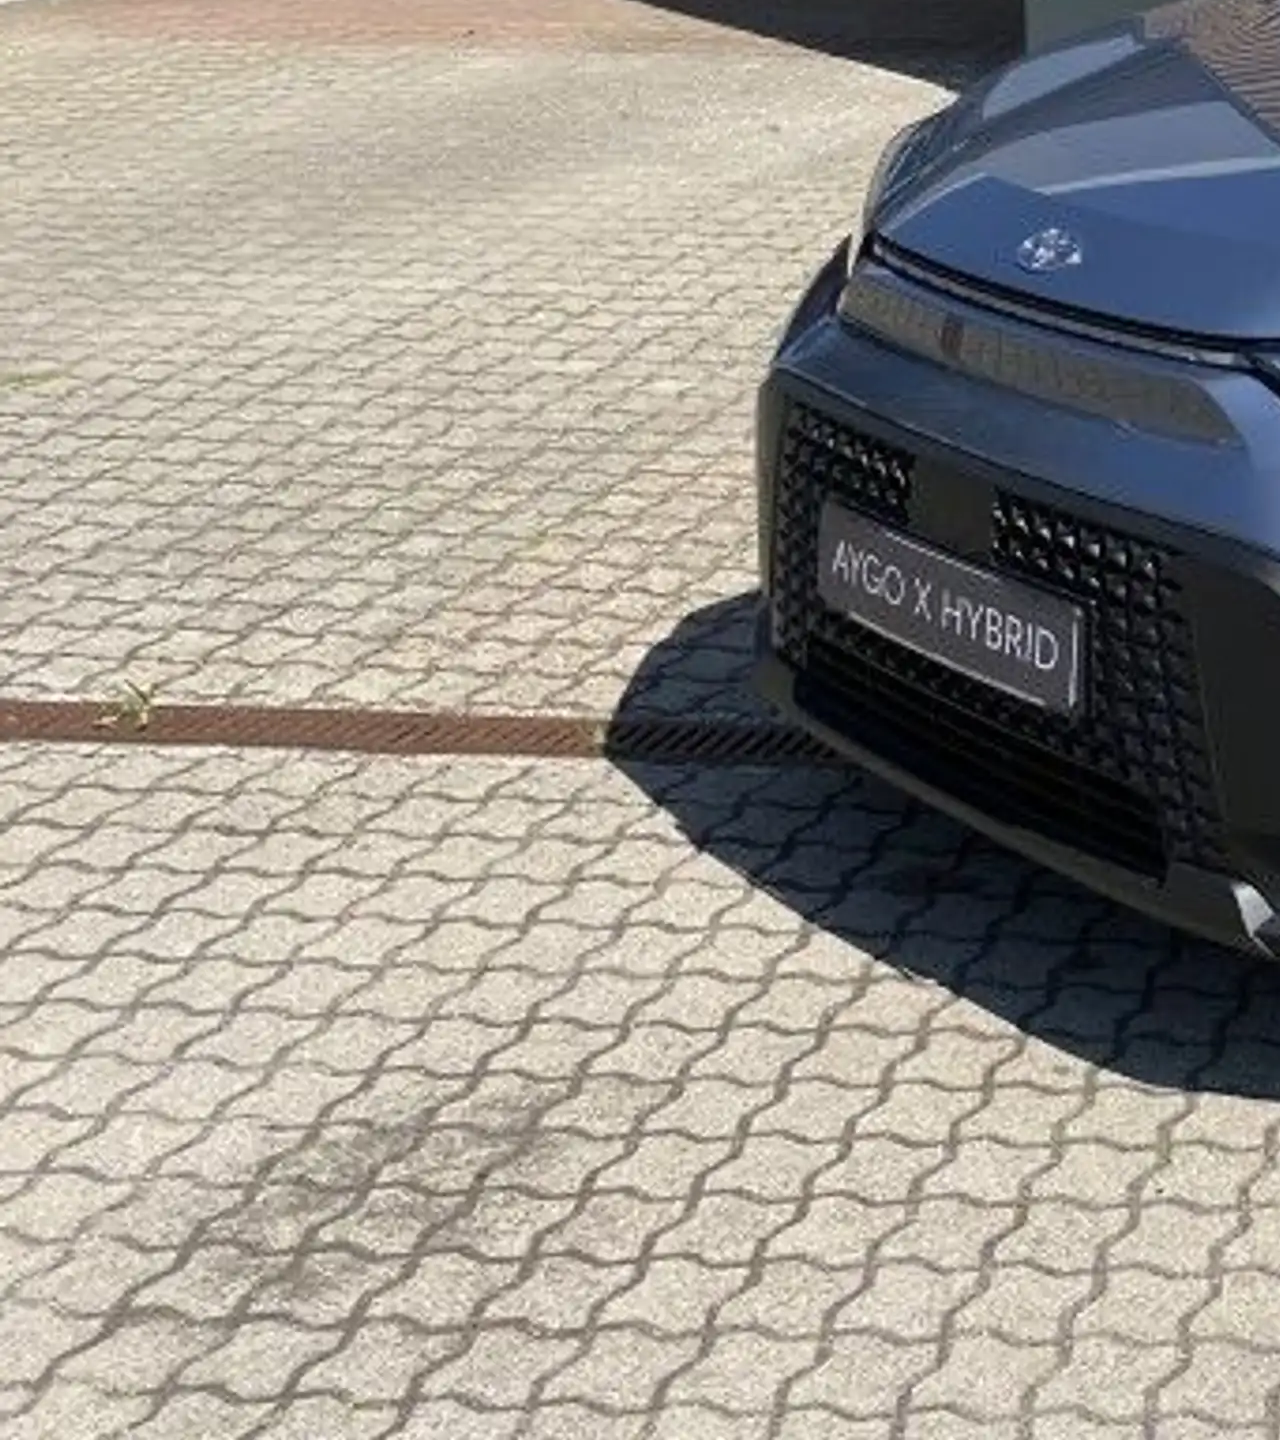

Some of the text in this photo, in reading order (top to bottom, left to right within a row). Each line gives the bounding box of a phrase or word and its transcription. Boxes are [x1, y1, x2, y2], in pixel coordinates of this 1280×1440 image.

[831, 539, 1060, 671] AYGO X HYBRID
